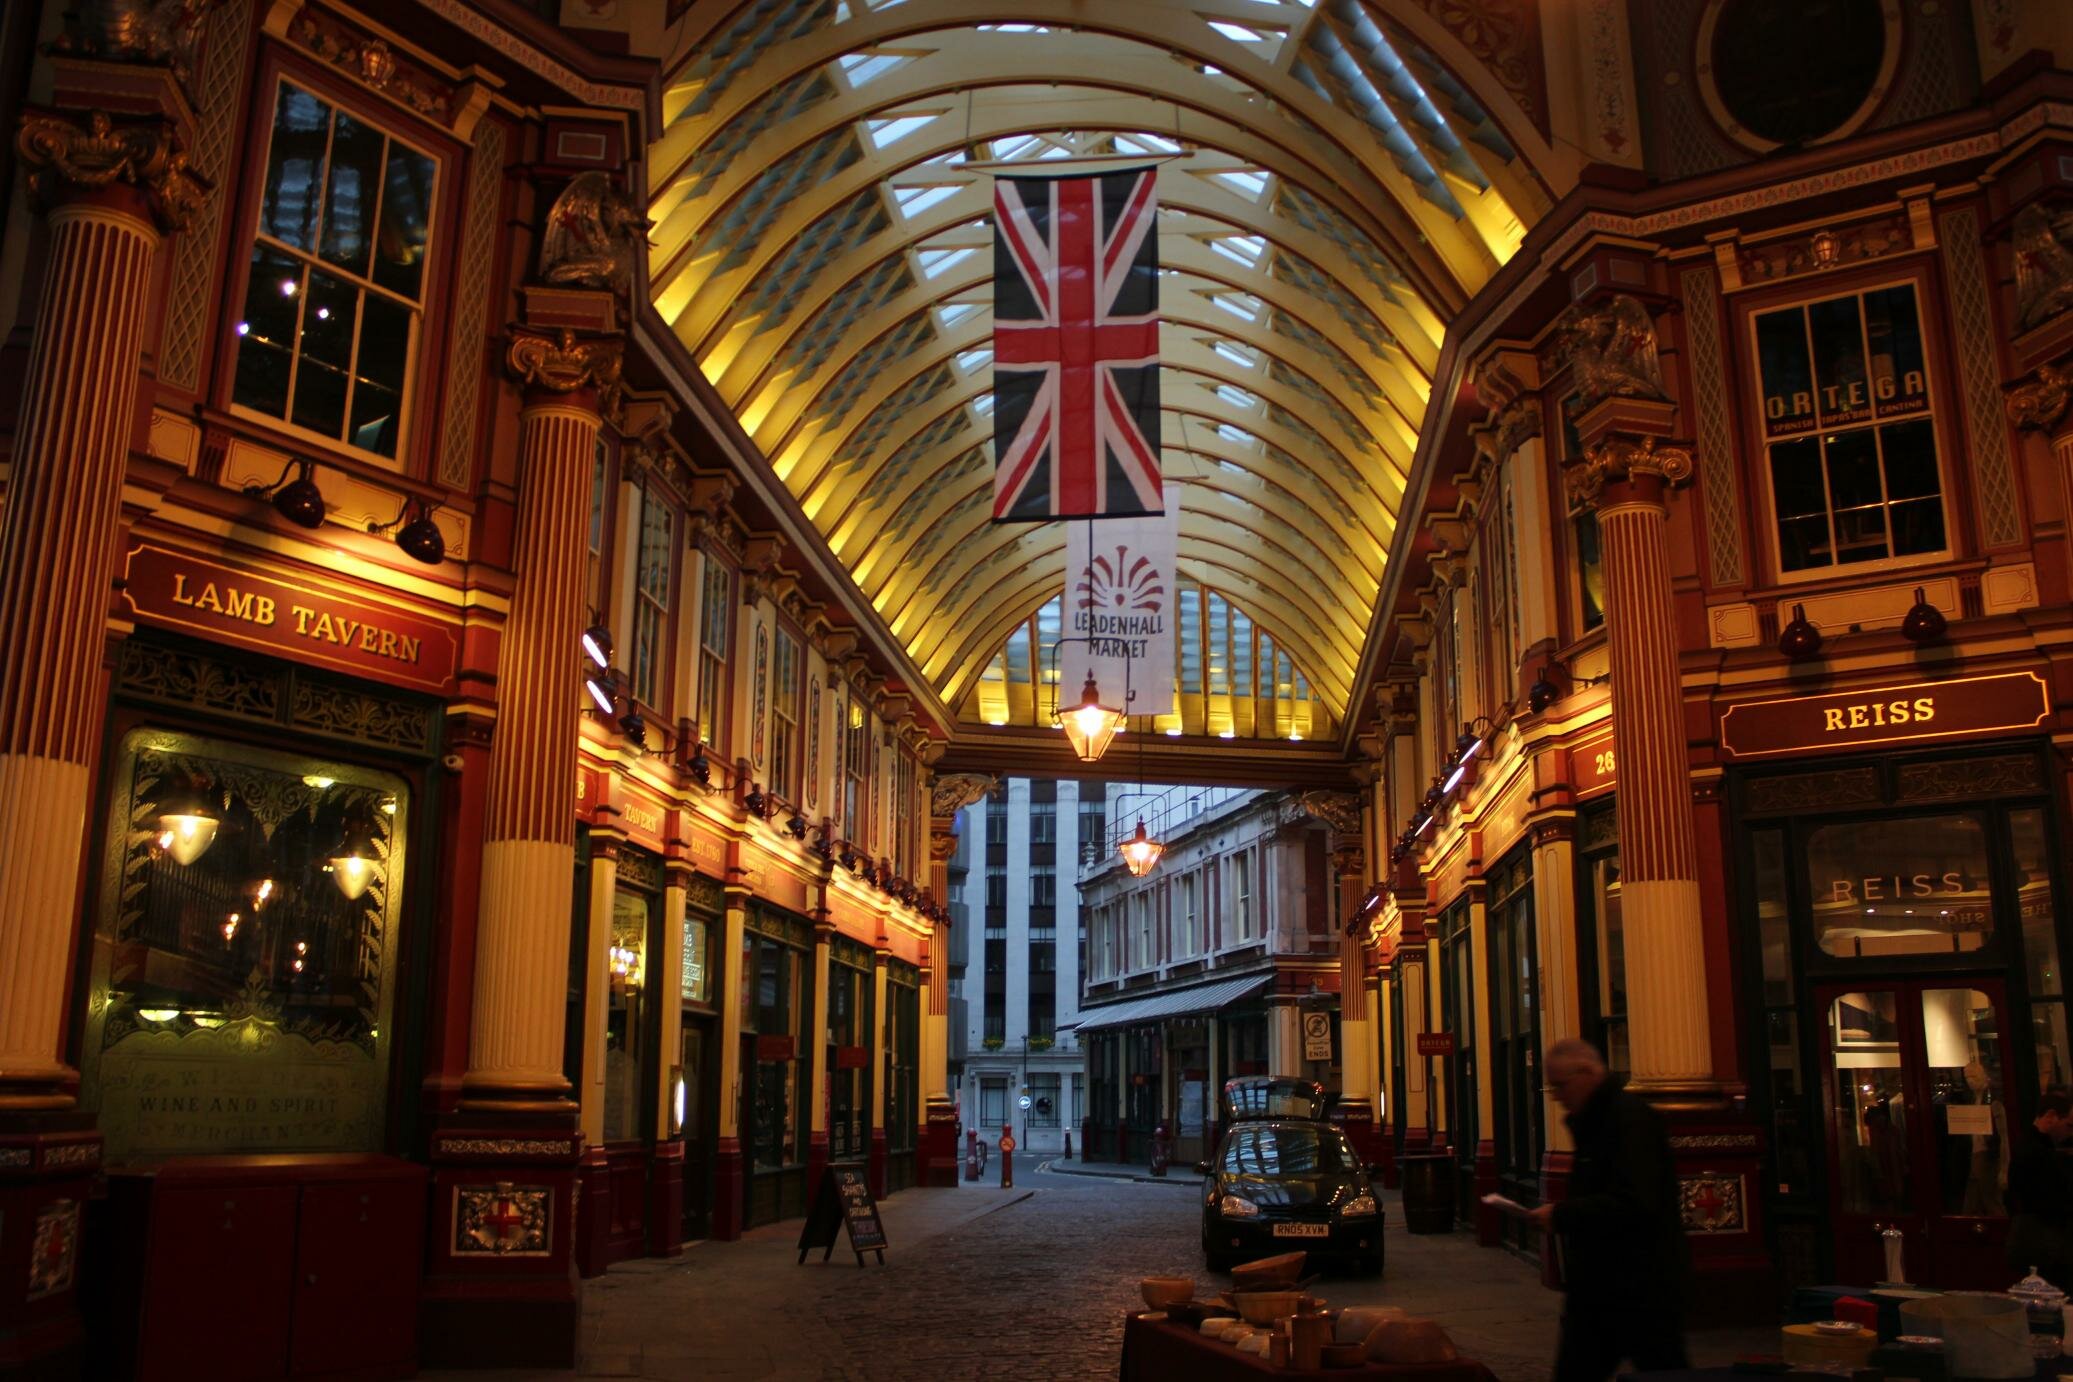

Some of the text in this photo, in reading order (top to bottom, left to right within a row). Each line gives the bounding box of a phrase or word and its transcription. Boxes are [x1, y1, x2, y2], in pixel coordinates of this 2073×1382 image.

[1766, 370, 1925, 420] ORTEGA
[173, 573, 423, 664] LAMB TAVERN
[1075, 611, 1164, 636] LEADENHALL
[1088, 639, 1148, 659] MARKET
[1823, 697, 1936, 732] REISS
[624, 802, 658, 834] TAVERN
[1832, 872, 1965, 902] REISS
[140, 1098, 338, 1114] WINE AND SPIRIT
